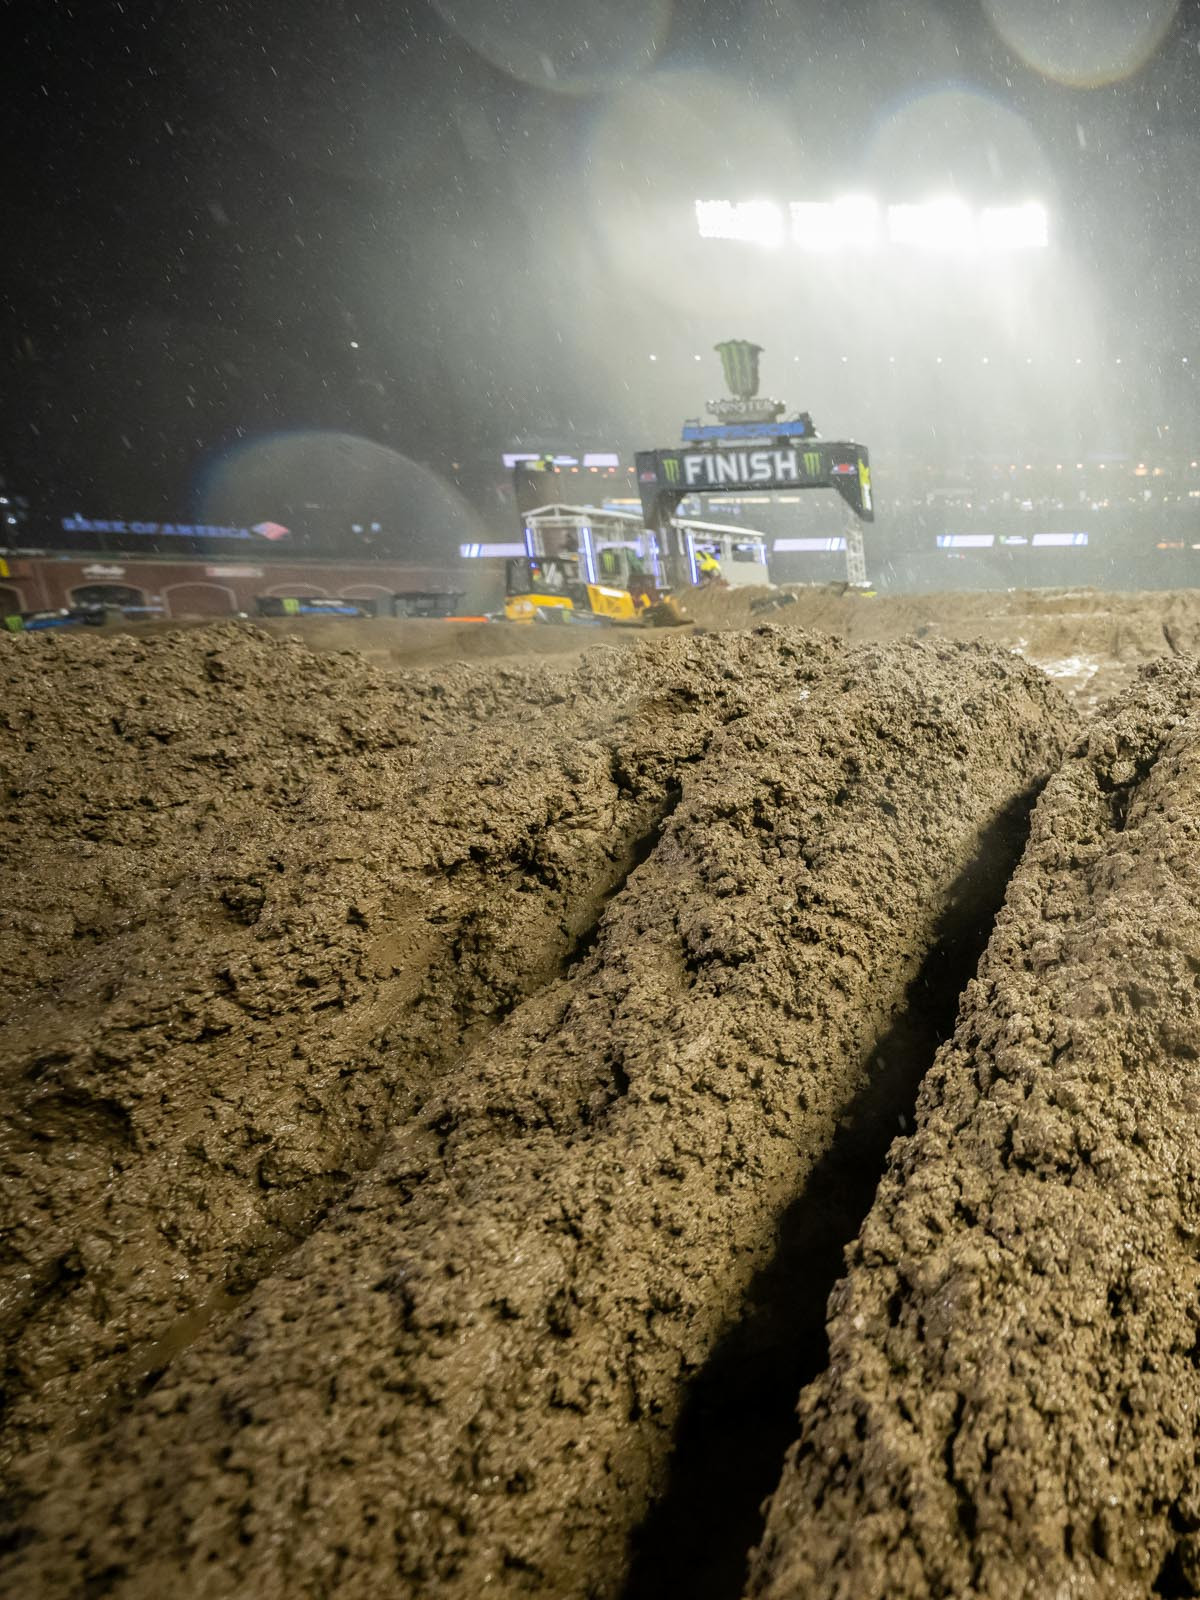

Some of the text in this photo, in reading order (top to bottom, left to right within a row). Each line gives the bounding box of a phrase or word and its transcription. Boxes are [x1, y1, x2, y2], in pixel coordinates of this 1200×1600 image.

[684, 450, 798, 485] FINISH
[62, 517, 251, 539] BANK OF AMERICA
